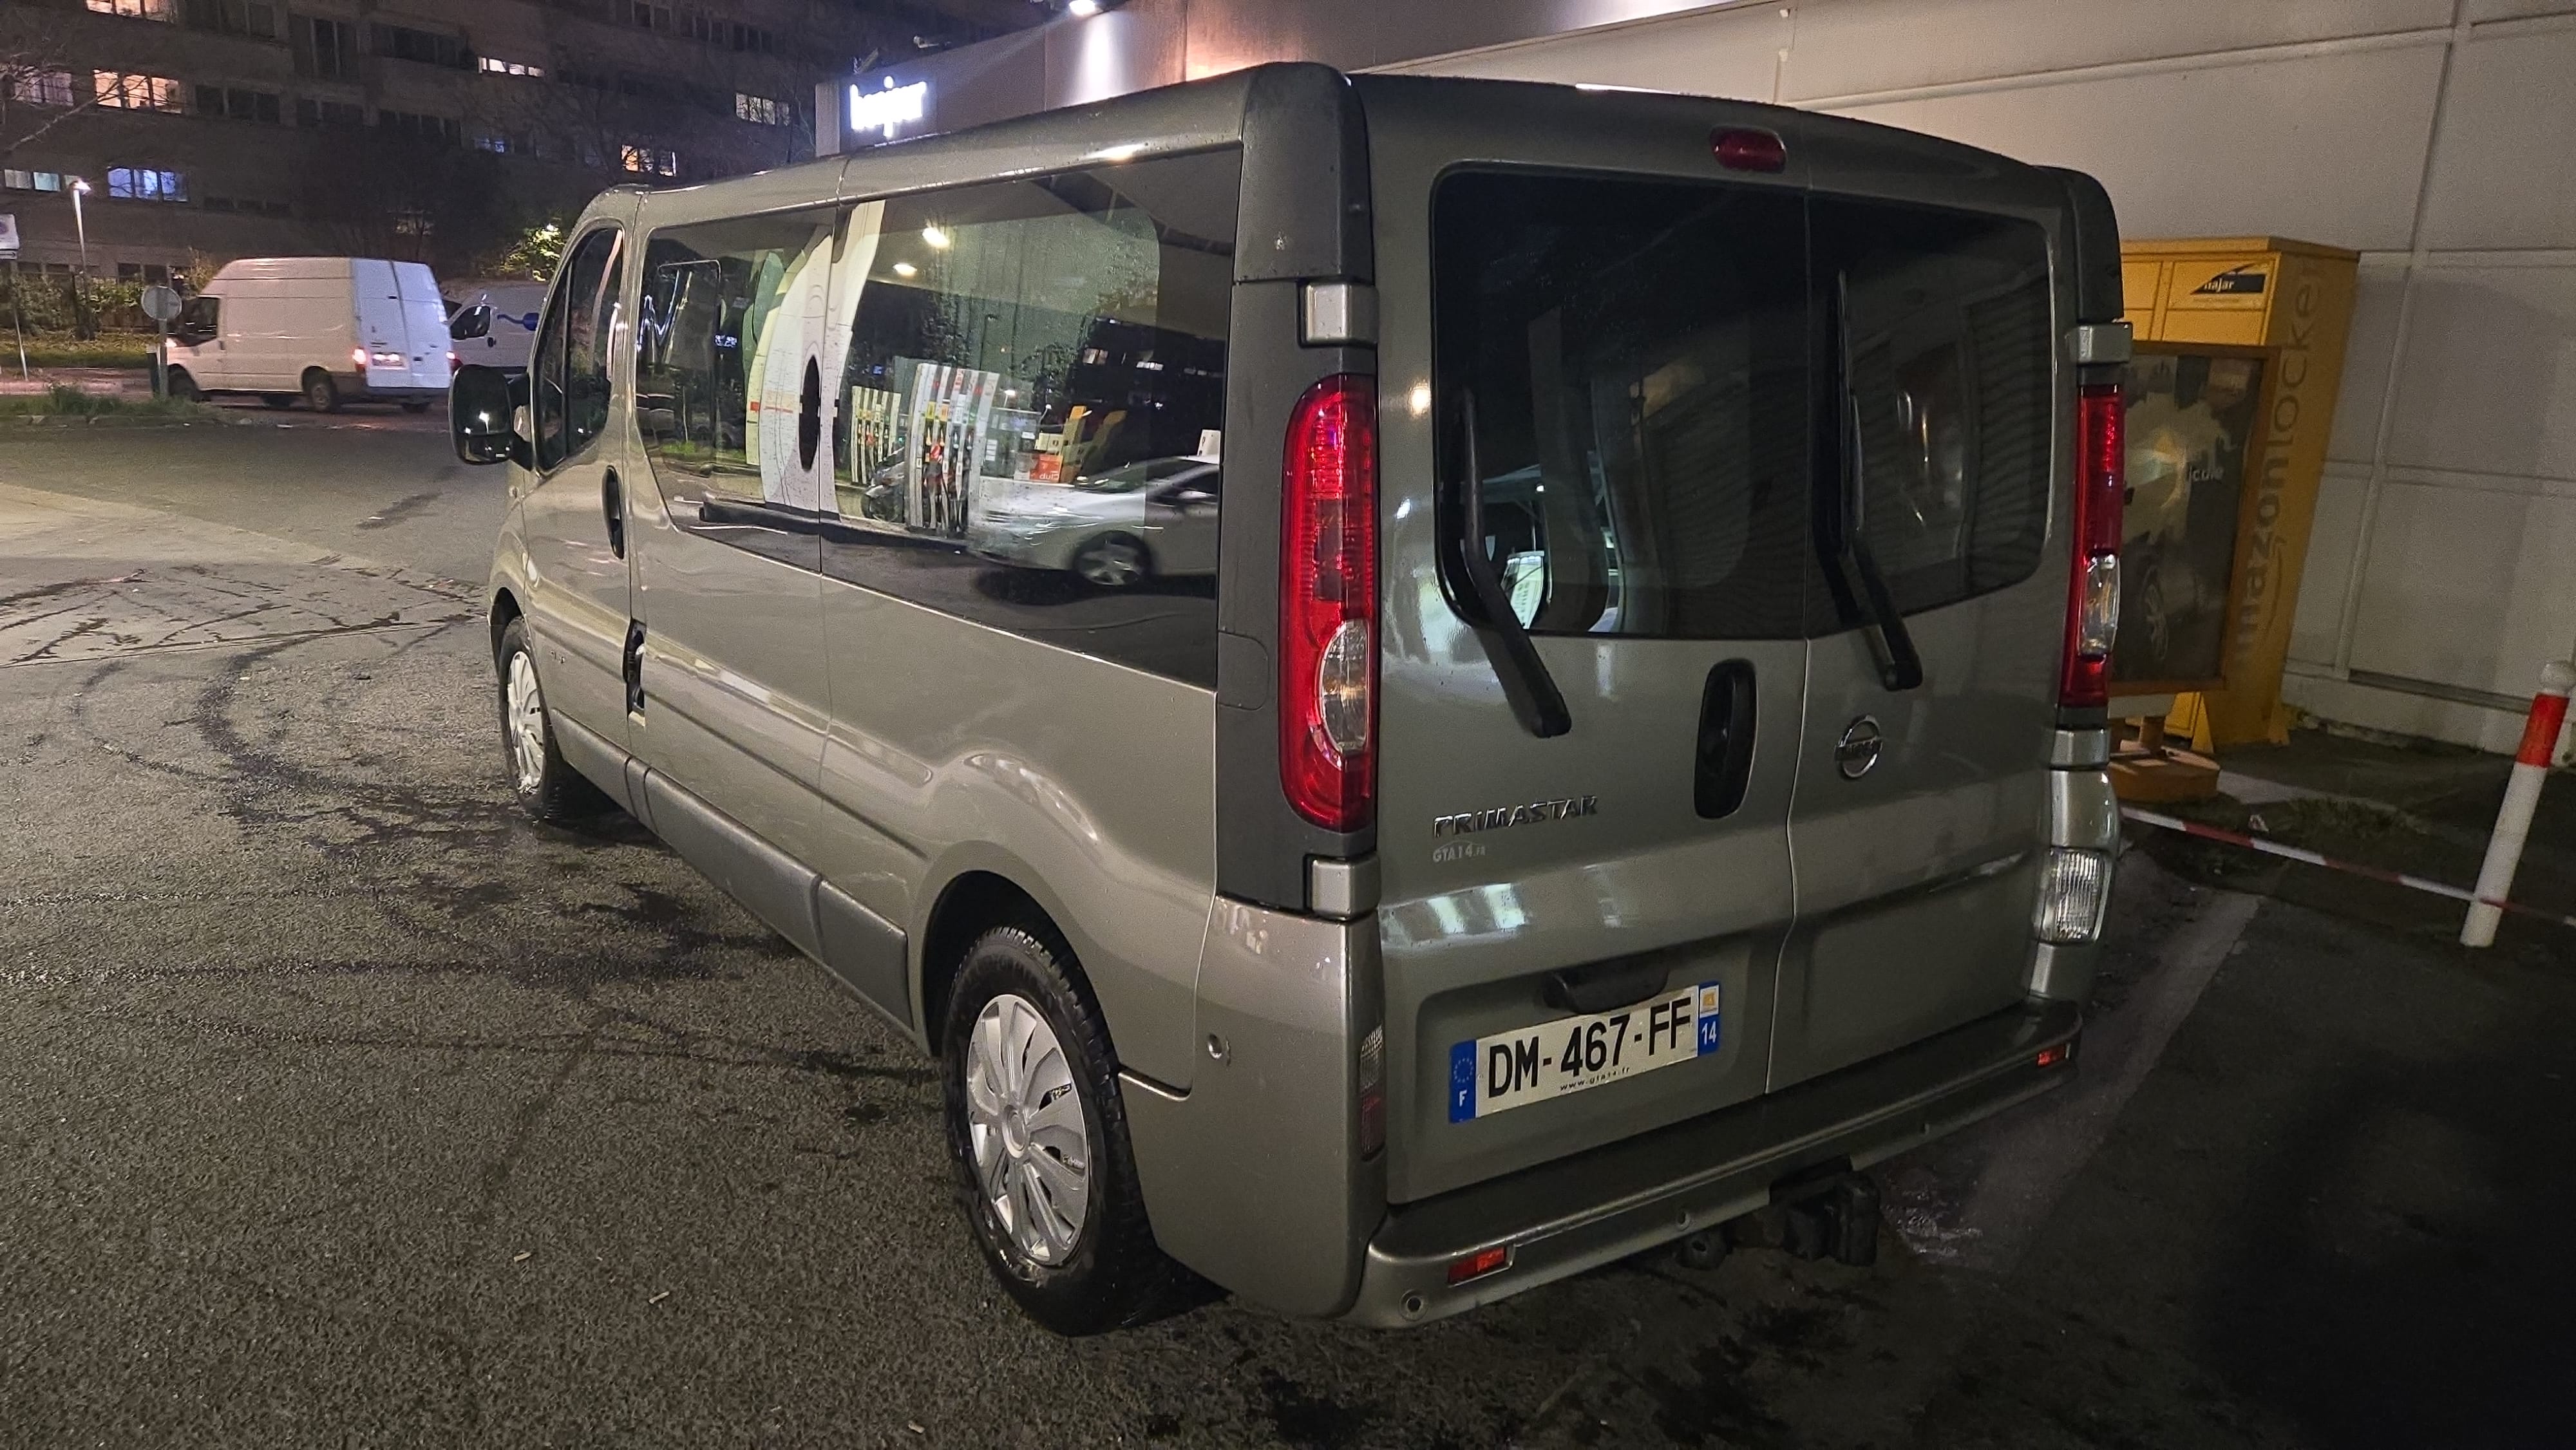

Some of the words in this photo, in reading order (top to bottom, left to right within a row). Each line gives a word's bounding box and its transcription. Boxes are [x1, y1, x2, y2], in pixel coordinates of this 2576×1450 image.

[1433, 795, 1598, 838] PRIMASTAR
[1701, 1021, 1717, 1045] 14
[1459, 1089, 1468, 1107] F
